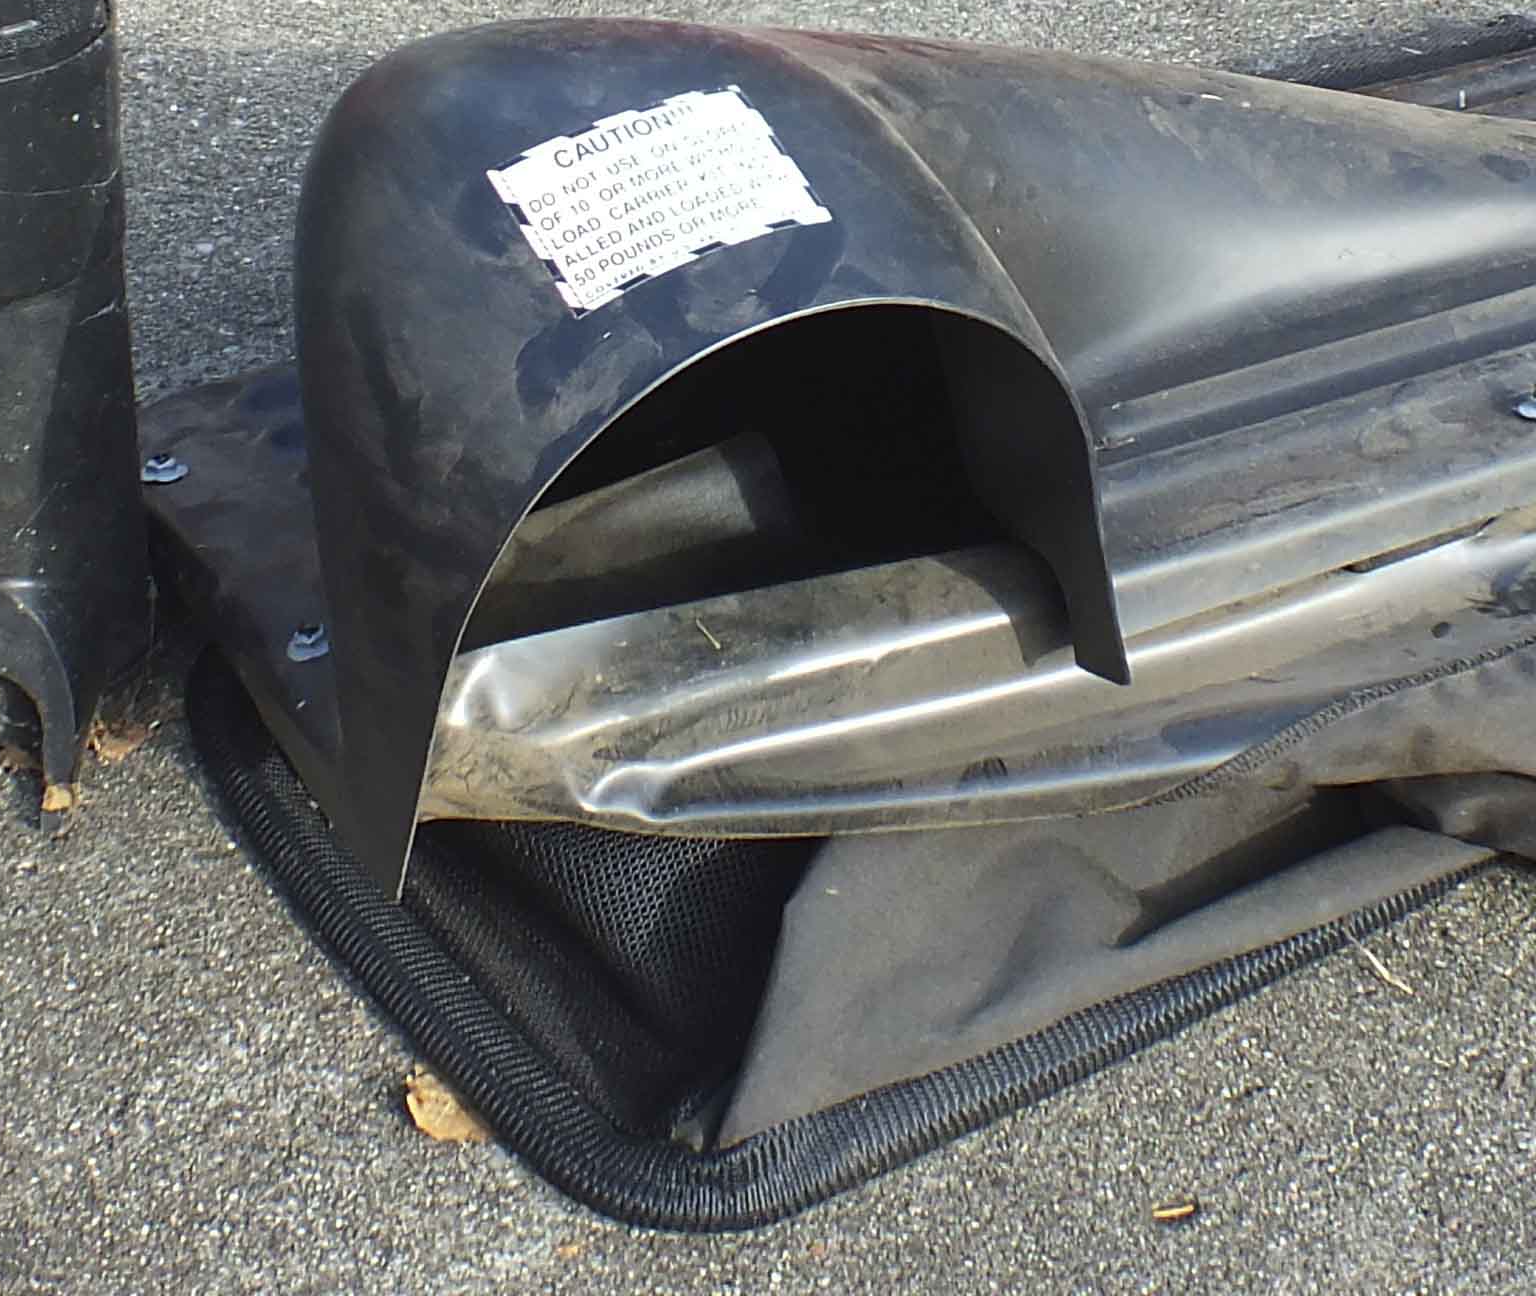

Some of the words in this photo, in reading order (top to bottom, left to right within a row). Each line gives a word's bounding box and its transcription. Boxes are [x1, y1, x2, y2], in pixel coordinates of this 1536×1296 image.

[528, 192, 556, 214] DO
[562, 170, 597, 195] NOT
[606, 154, 640, 176] USE
[540, 211, 563, 231] OF
[570, 199, 591, 215] 10
[599, 182, 625, 202] OR
[629, 161, 681, 187] MORE
[551, 217, 601, 250] LOAD
[608, 179, 689, 221] CARRIER
[564, 230, 623, 267] ALLED
[627, 210, 665, 236] AND
[669, 184, 743, 217] LOADED
[574, 267, 596, 286] 50
[598, 229, 676, 272] POUNDS
[679, 212, 706, 234] OR
[709, 198, 758, 222] MORE
